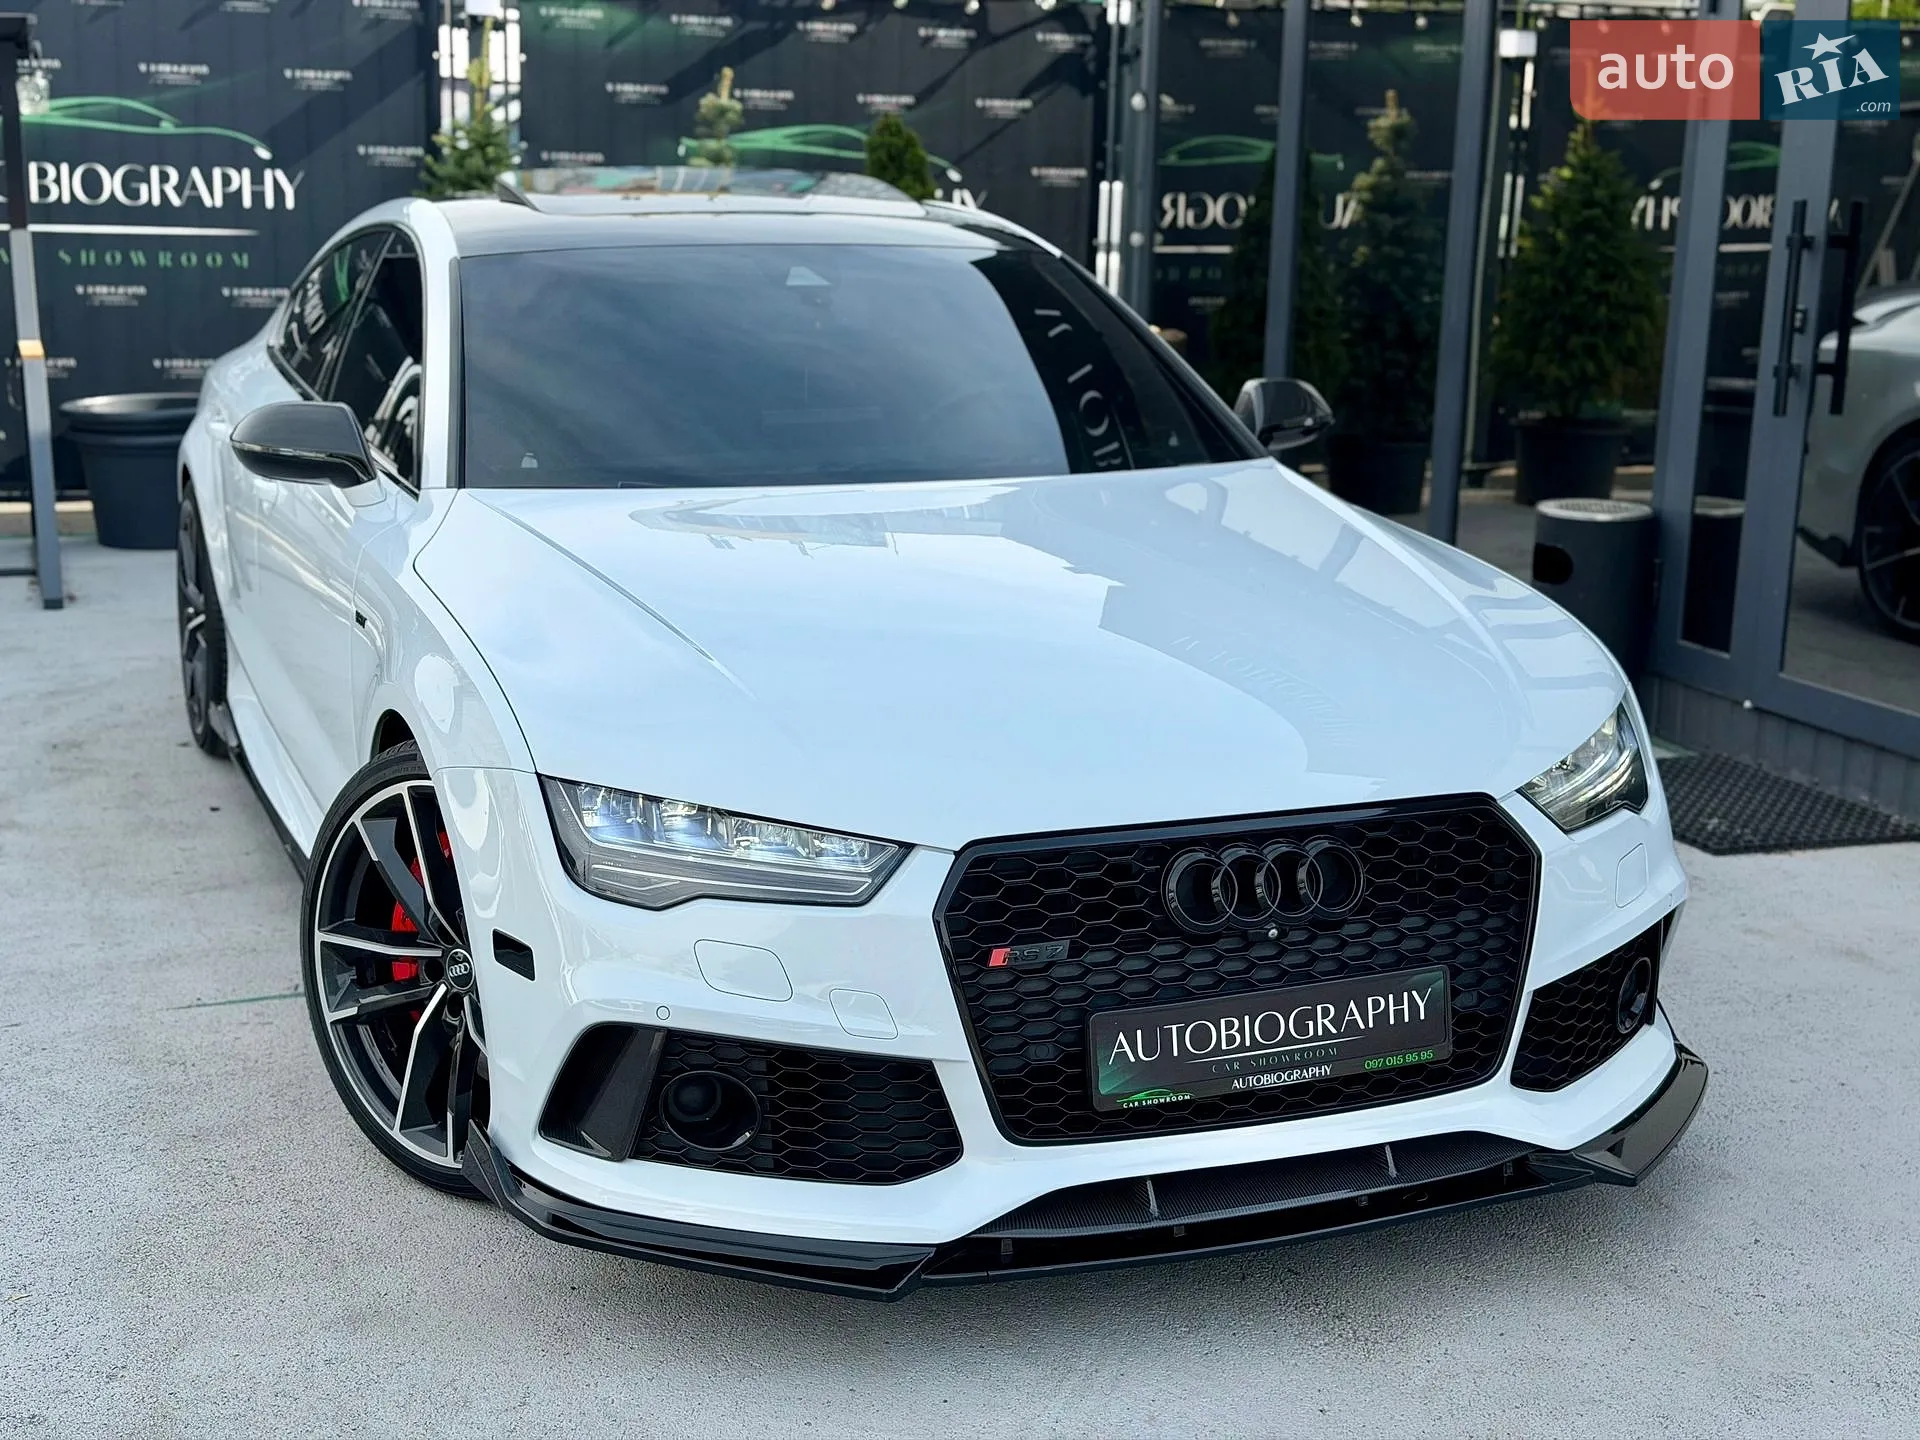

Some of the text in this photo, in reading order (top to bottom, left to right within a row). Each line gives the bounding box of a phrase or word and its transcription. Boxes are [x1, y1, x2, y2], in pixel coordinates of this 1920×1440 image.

[0, 161, 305, 210] BIOGRAPHY
[57, 248, 249, 269] SHOWROOM
[1108, 987, 1432, 1065] AUTOBIOGRAPHY
[1212, 1046, 1338, 1073] CAR SHOWROOM
[1365, 1050, 1433, 1070] 097 015 95 95
[1231, 1063, 1333, 1090] AUTOBIOGRAPHY
[1142, 1094, 1191, 1105] SHOWROOM
